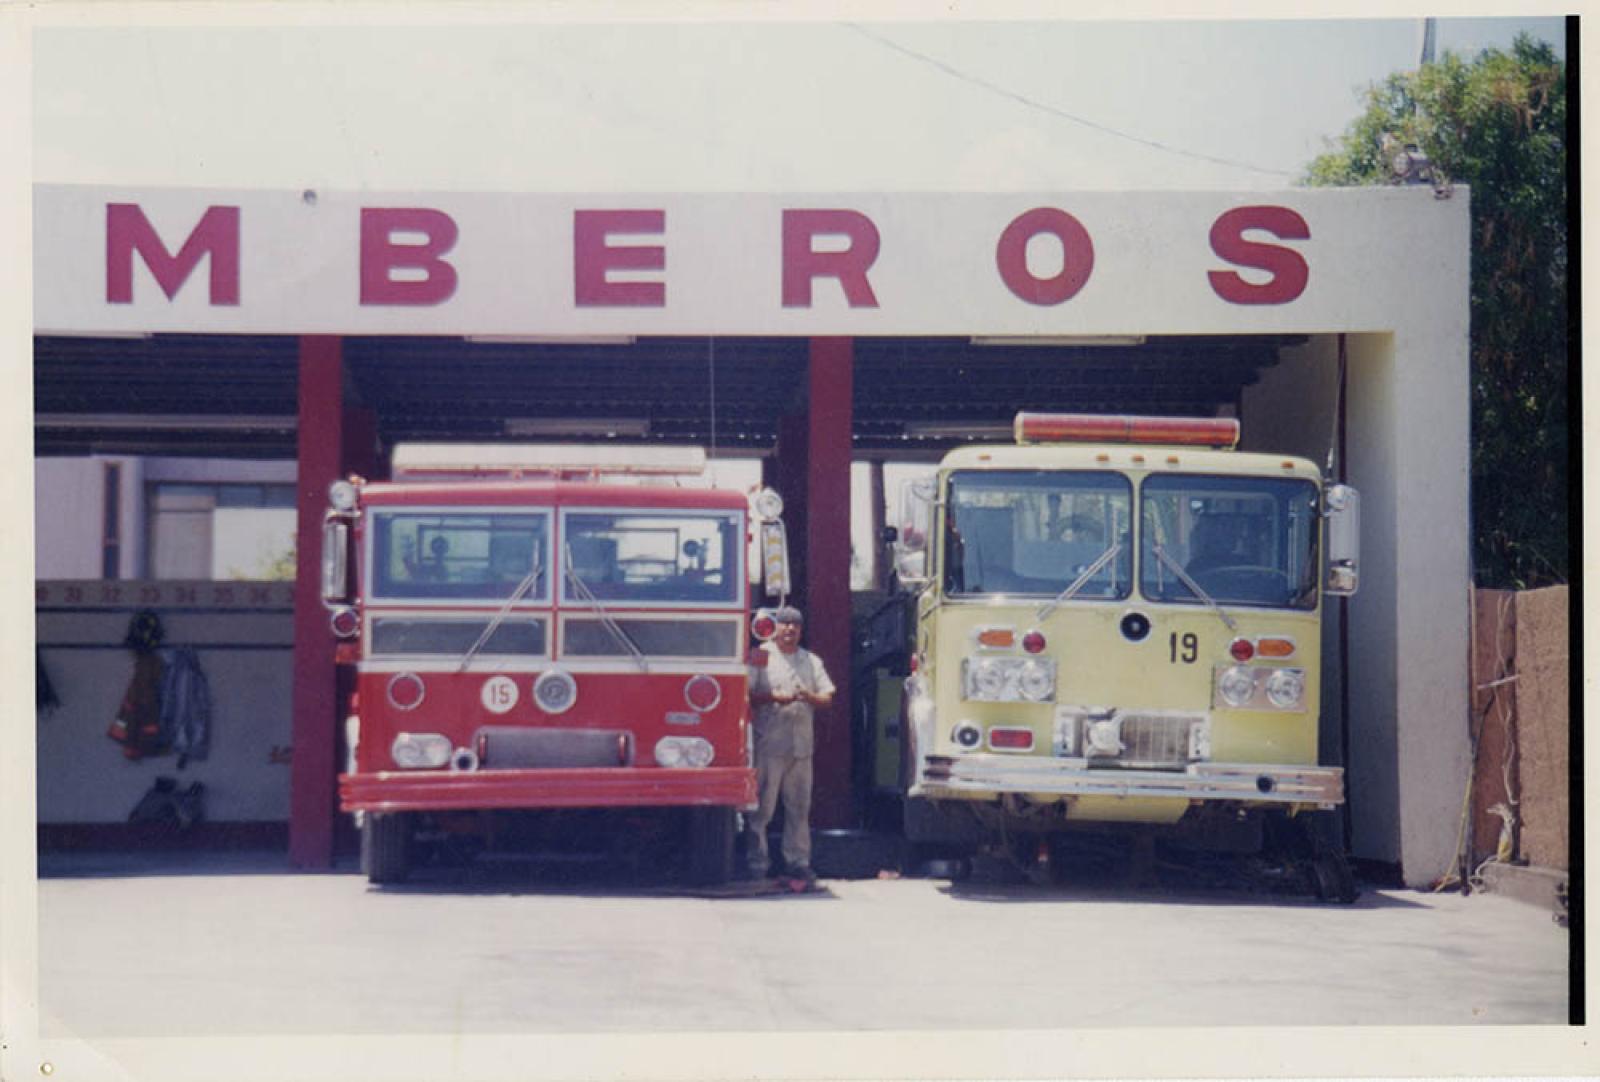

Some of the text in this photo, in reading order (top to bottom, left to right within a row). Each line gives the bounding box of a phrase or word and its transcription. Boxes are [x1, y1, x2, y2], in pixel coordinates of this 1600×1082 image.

[106, 203, 1310, 308] MBEROS
[1170, 632, 1198, 664] 19
[491, 683, 510, 704] 15
